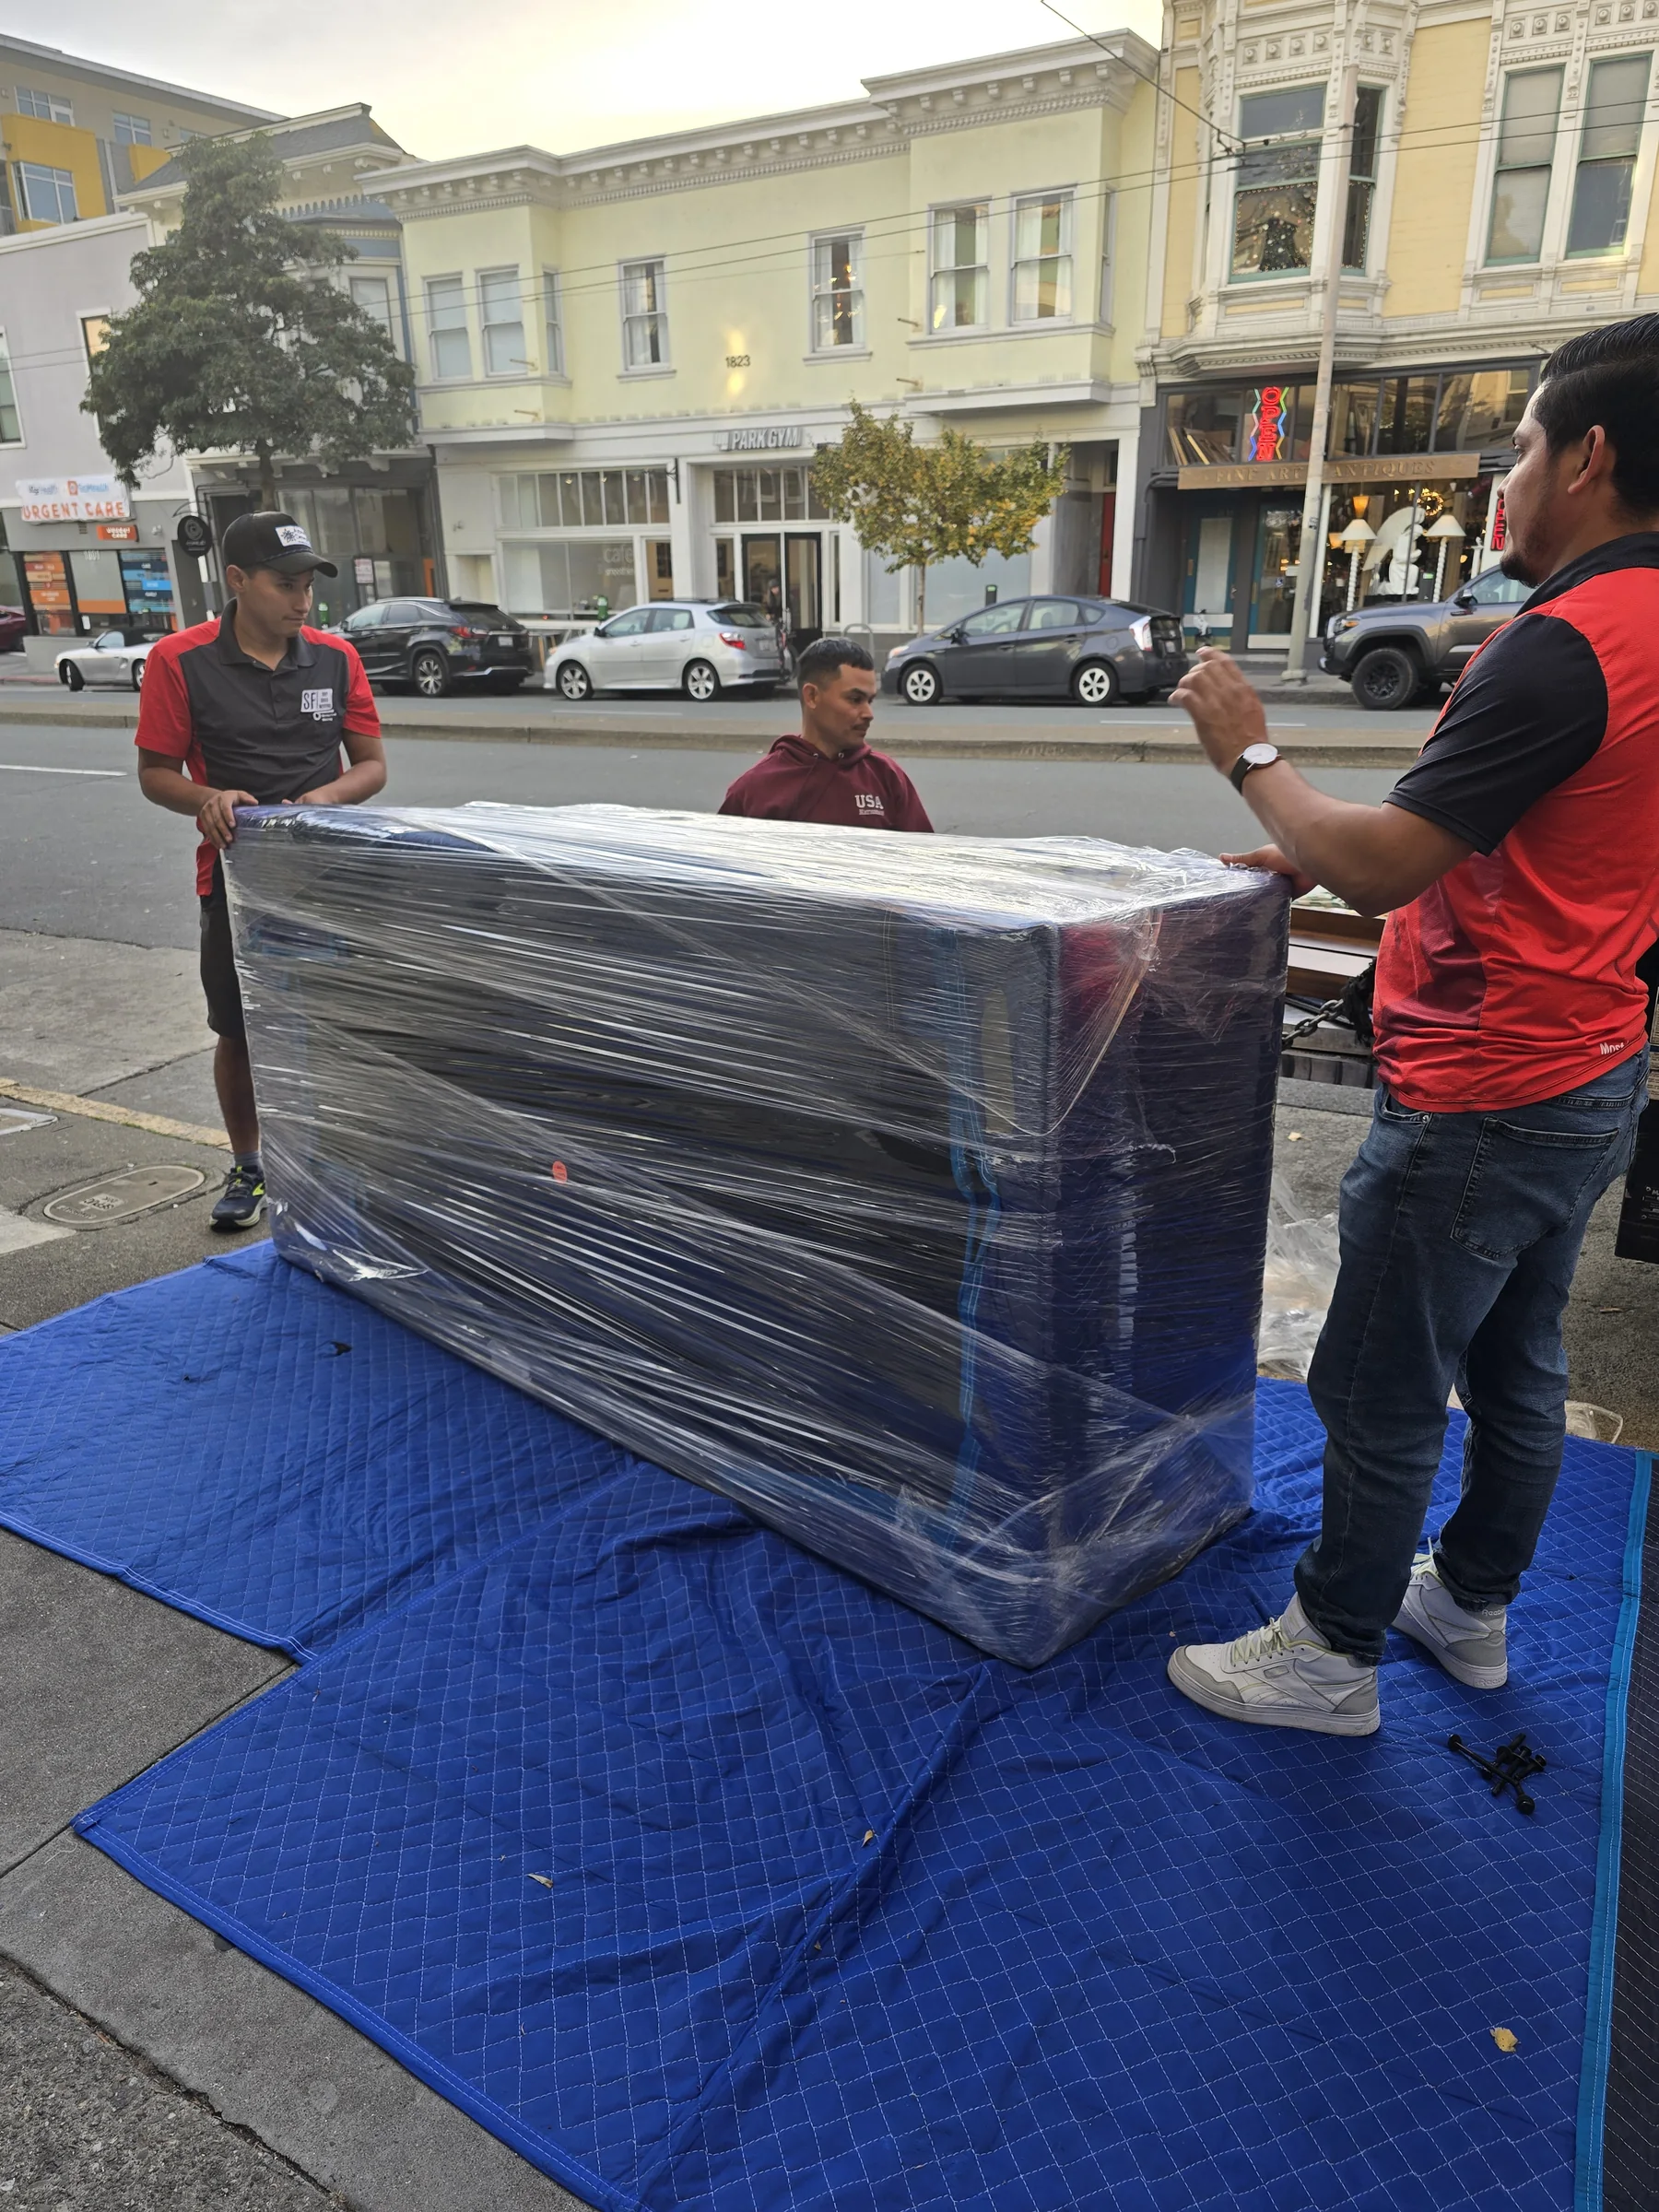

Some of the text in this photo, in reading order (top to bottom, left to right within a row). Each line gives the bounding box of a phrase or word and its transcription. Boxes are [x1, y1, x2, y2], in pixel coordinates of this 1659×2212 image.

[725, 354, 751, 369] 1823
[1256, 386, 1282, 462] OPEN
[732, 427, 799, 450] PARK GYM
[1217, 467, 1258, 482] FINE
[1333, 461, 1436, 478] ANTIQUES
[21, 501, 125, 519] URGENT CARE
[303, 692, 316, 710] SF
[854, 794, 884, 809] USA
